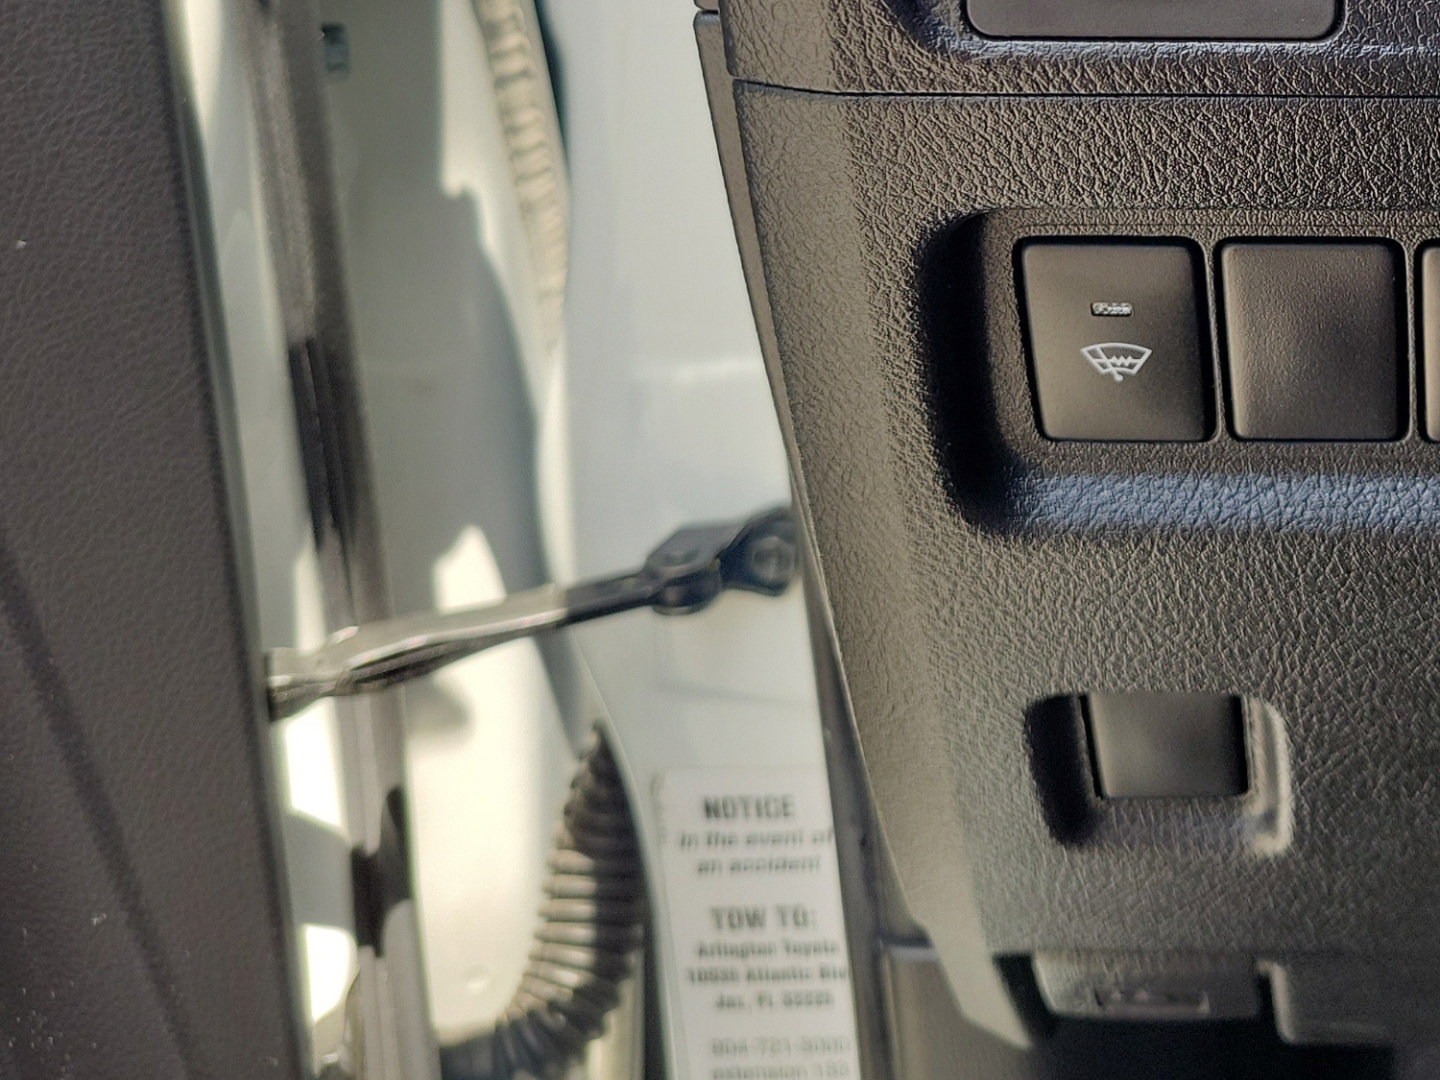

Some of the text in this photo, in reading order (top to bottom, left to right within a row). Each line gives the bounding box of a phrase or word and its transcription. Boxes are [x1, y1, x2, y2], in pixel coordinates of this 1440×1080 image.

[703, 794, 796, 819] NOTICE
[706, 830, 738, 847] the
[746, 829, 804, 846] event
[710, 906, 767, 930] TOW
